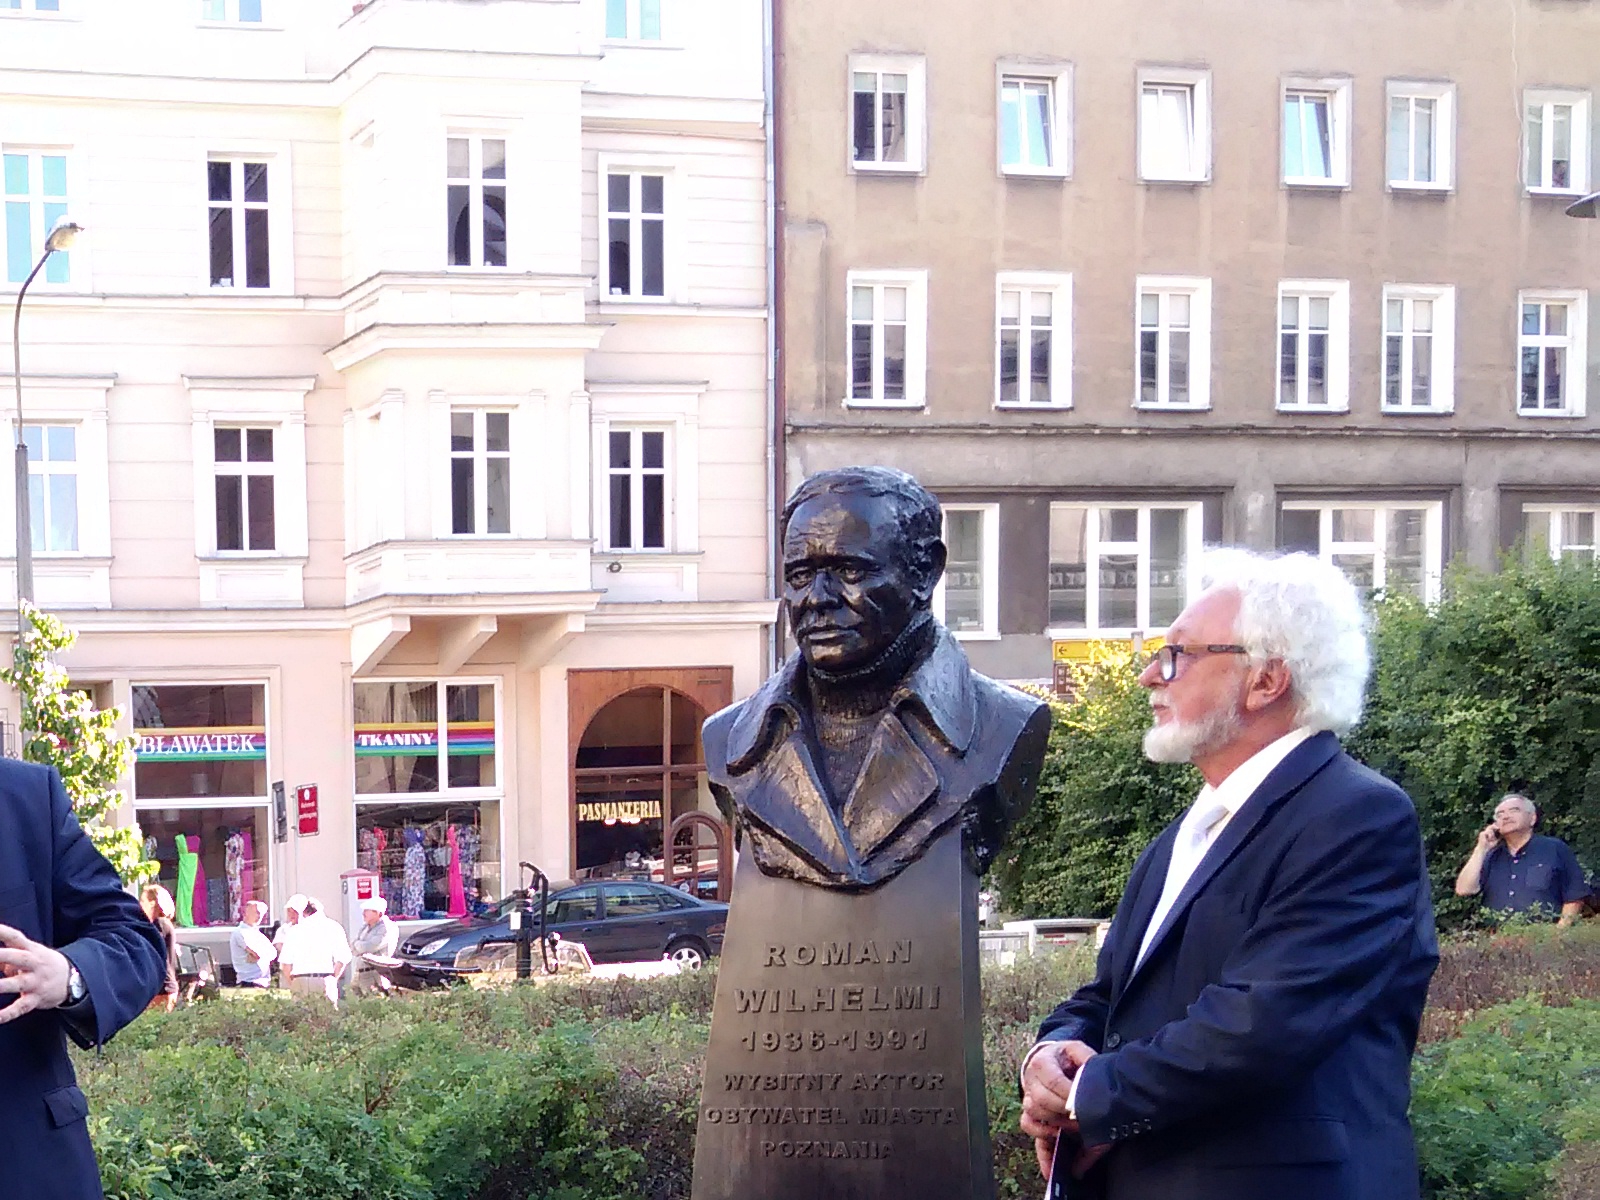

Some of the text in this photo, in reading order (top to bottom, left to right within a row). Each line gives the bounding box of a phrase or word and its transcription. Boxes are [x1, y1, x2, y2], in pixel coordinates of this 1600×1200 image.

[140, 733, 257, 754] BŁAWATEK
[358, 732, 434, 746] TKANINY
[578, 800, 662, 821] PASMANTERIA
[763, 939, 913, 967] ROMAN
[734, 984, 941, 1013] WILHELMI
[741, 1028, 928, 1052] 1936-1991
[723, 1072, 945, 1092] WYBITNY AKTOR
[704, 1106, 960, 1126] OBYWATEL MIASTA
[759, 1140, 897, 1159] POZNANIA
